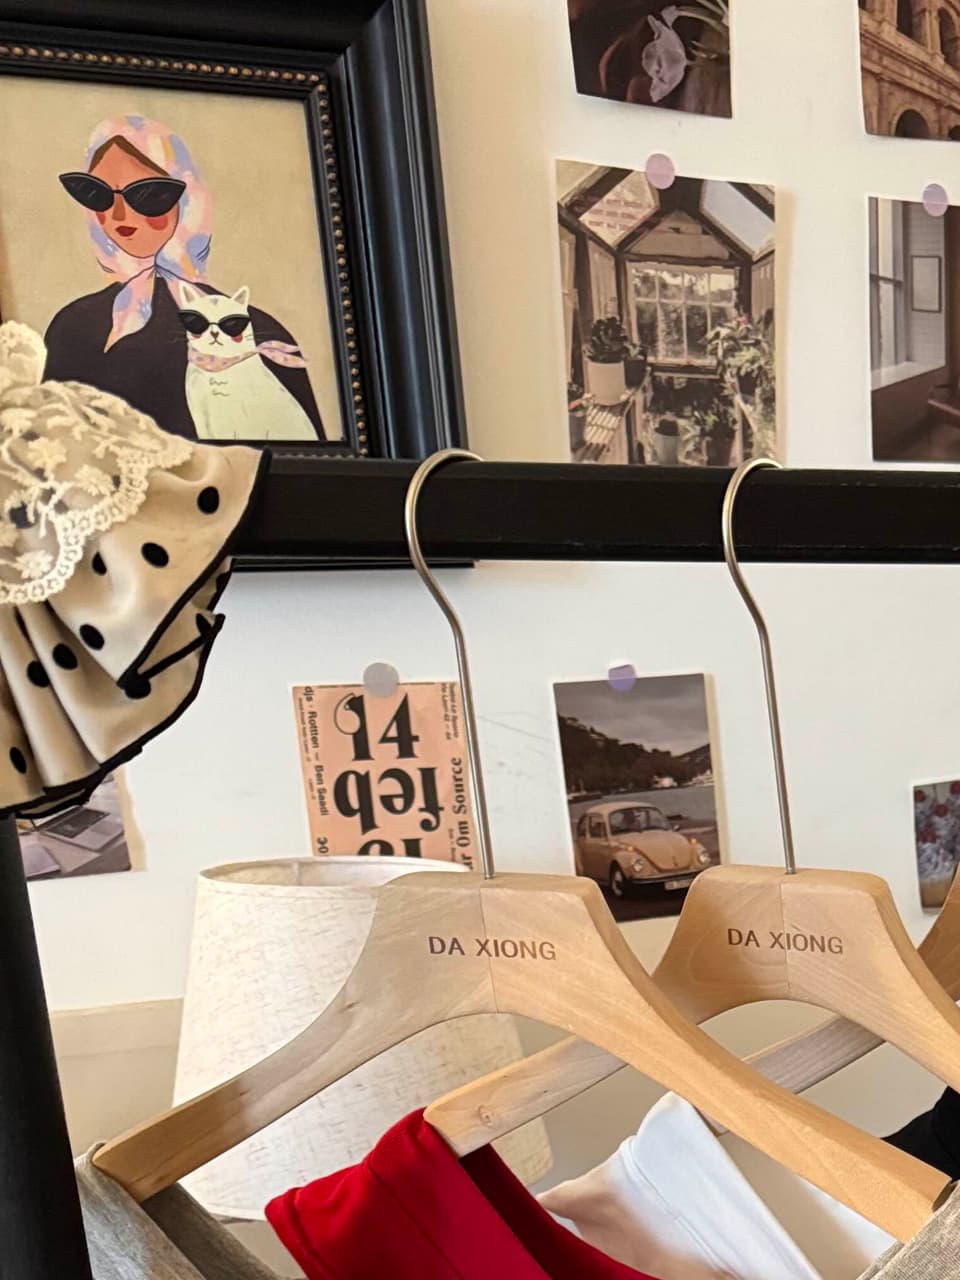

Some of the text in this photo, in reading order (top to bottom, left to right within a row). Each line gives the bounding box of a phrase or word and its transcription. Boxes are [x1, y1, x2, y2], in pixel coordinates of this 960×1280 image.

[333, 692, 420, 762] 14
[333, 767, 444, 836] feb
[451, 757, 468, 815] Source
[428, 936, 557, 961] DA XIONG
[727, 928, 844, 955] DA XIONG
